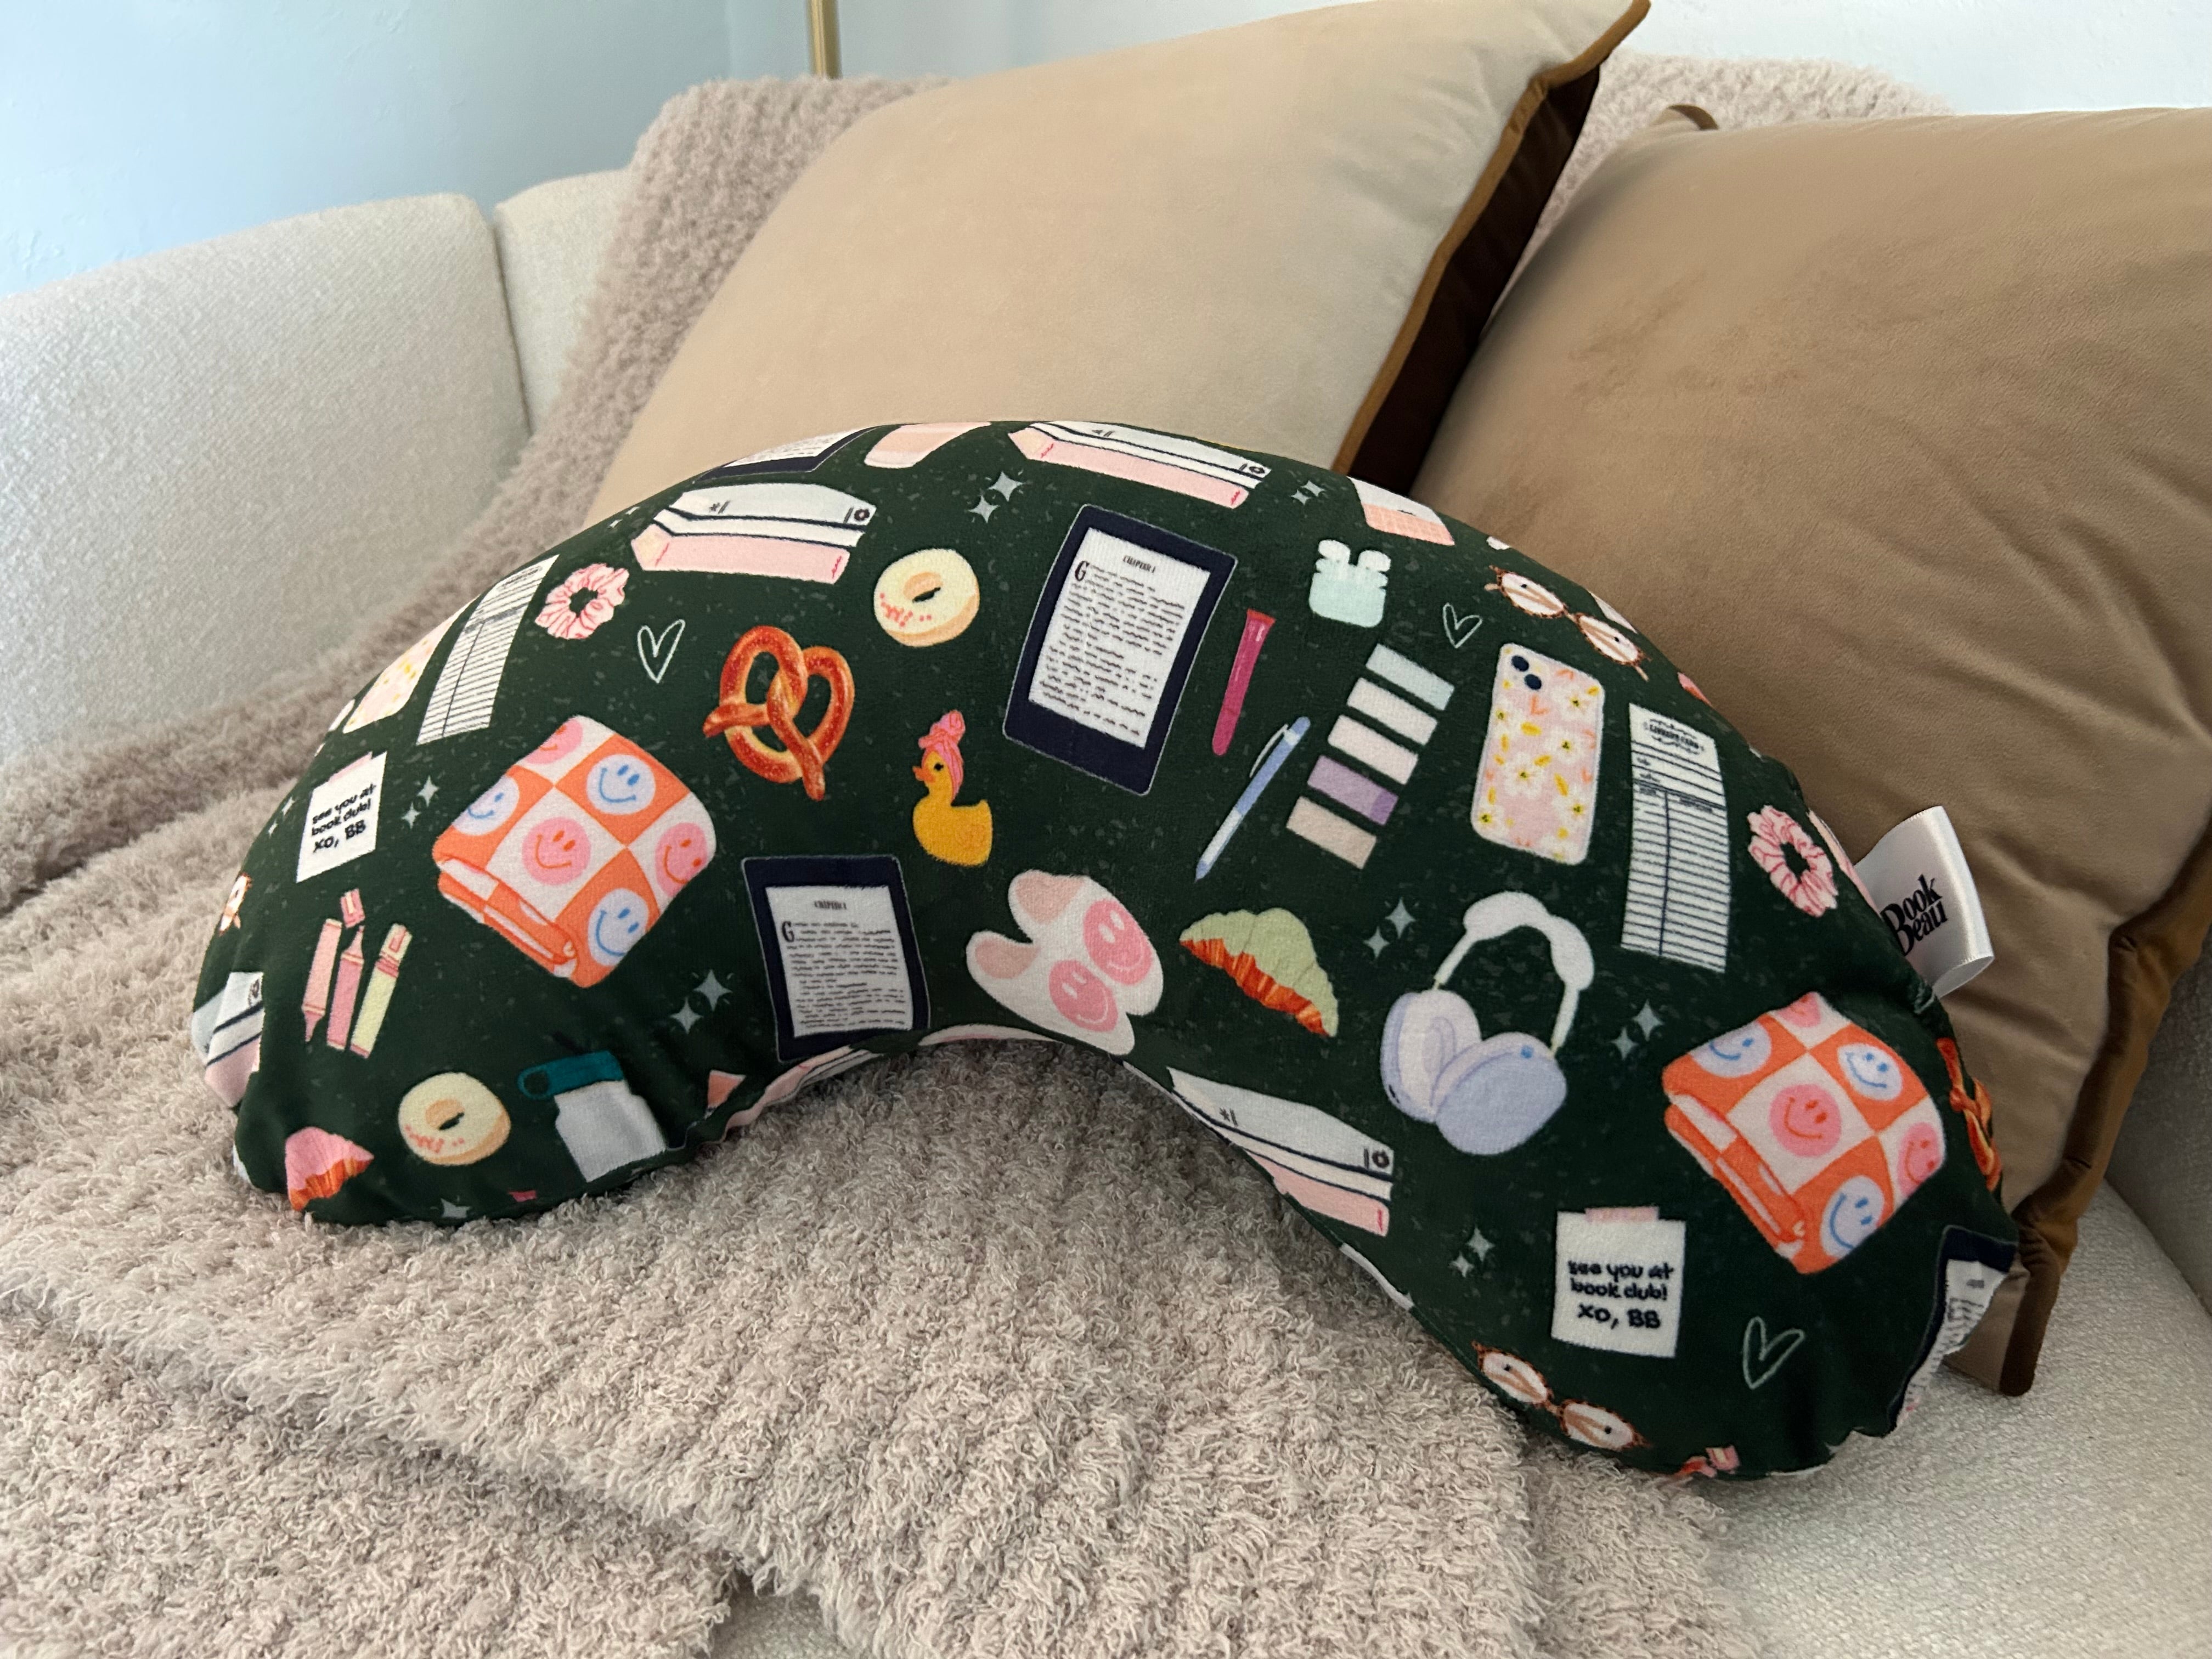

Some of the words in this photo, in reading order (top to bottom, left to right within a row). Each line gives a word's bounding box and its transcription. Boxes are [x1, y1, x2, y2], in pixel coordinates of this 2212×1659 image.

[1074, 560, 1090, 582] G
[313, 808, 332, 824] see
[335, 794, 358, 814] you
[360, 783, 376, 799] at
[312, 816, 341, 836] book
[343, 798, 371, 822] club!
[345, 820, 366, 840] BB
[1880, 873, 1943, 931] Book
[781, 921, 794, 943] G
[1567, 1261, 1601, 1274] see
[1606, 1263, 1643, 1282] you
[1648, 1262, 1674, 1279] at
[1570, 1278, 1621, 1298] book
[1623, 1283, 1668, 1301] club!
[1627, 1308, 1661, 1329] BB
